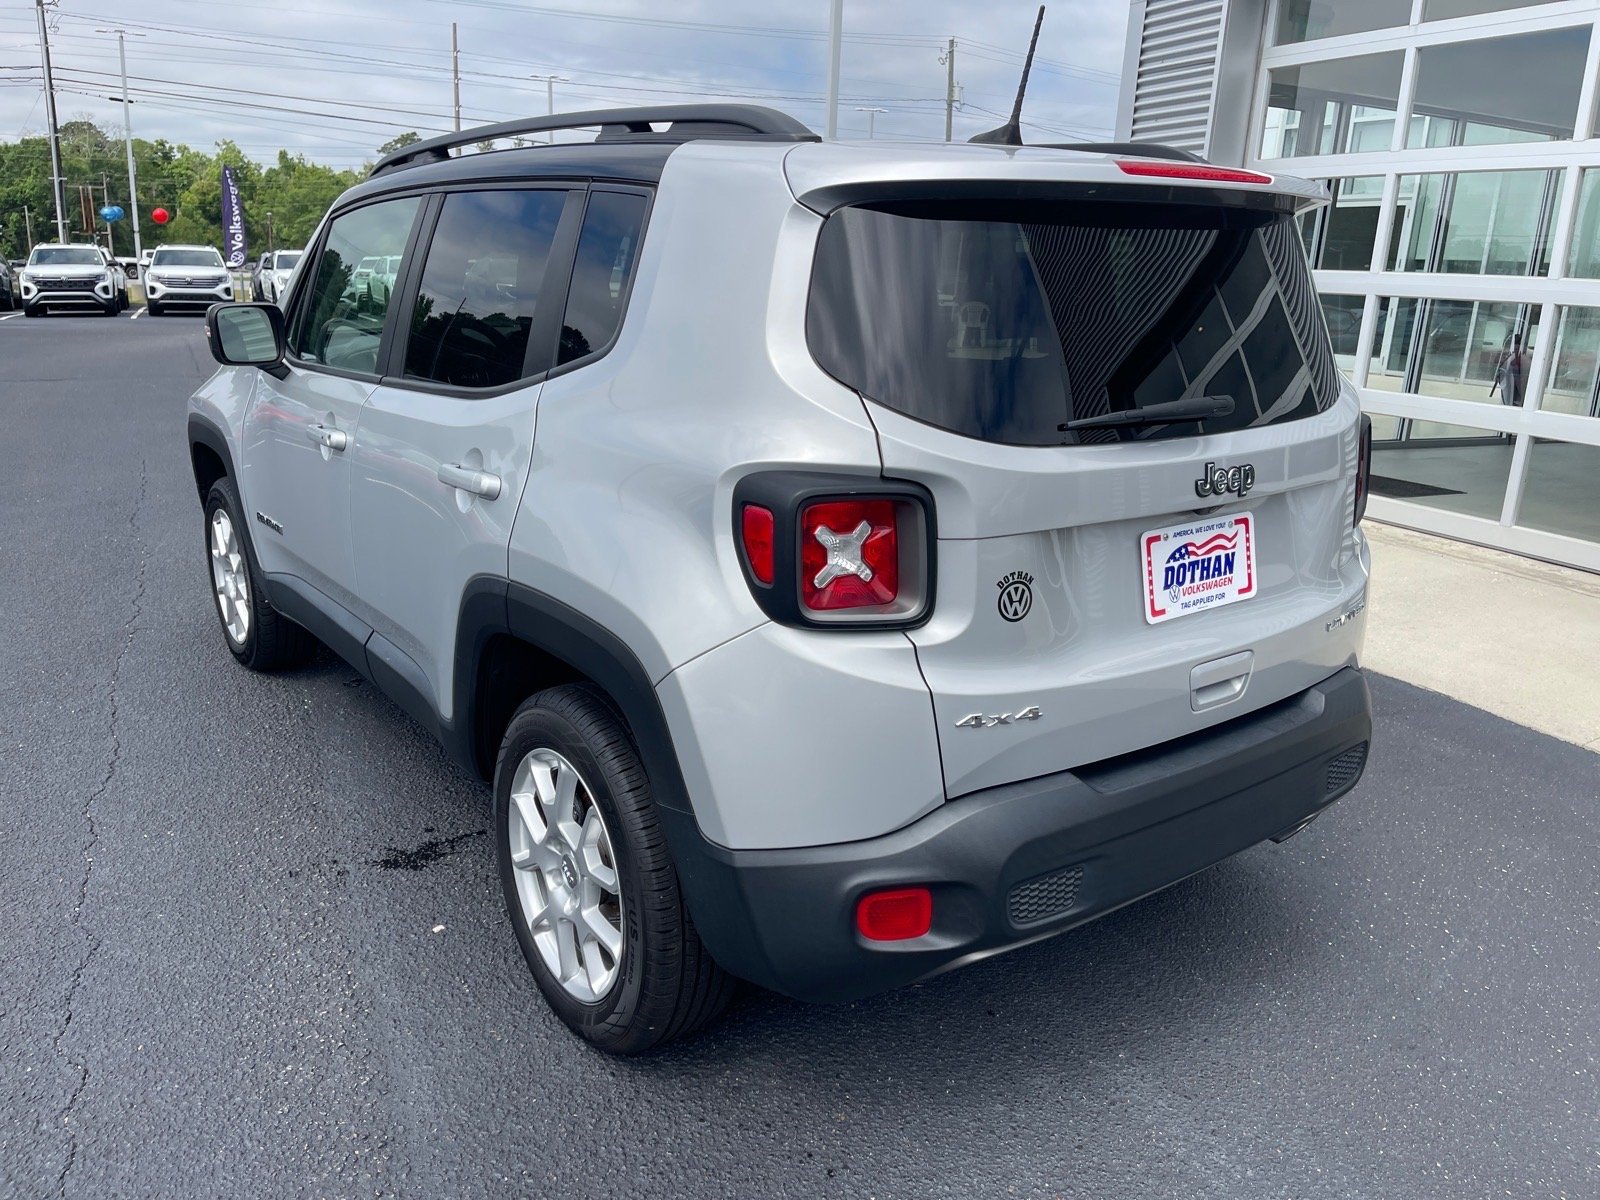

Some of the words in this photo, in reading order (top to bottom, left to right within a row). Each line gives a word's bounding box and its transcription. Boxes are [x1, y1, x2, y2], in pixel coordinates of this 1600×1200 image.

[1195, 461, 1255, 498] Jeep
[1172, 529, 1194, 538] AMERICA,
[1203, 524, 1215, 532] LOVE
[996, 570, 1034, 590] DOTHAN
[1163, 551, 1236, 591] DOTHAN
[1182, 575, 1233, 597] VOLKSWAGEN
[1181, 601, 1191, 610] TAG
[1192, 595, 1214, 607] APPLIED
[1215, 592, 1226, 601] FOR
